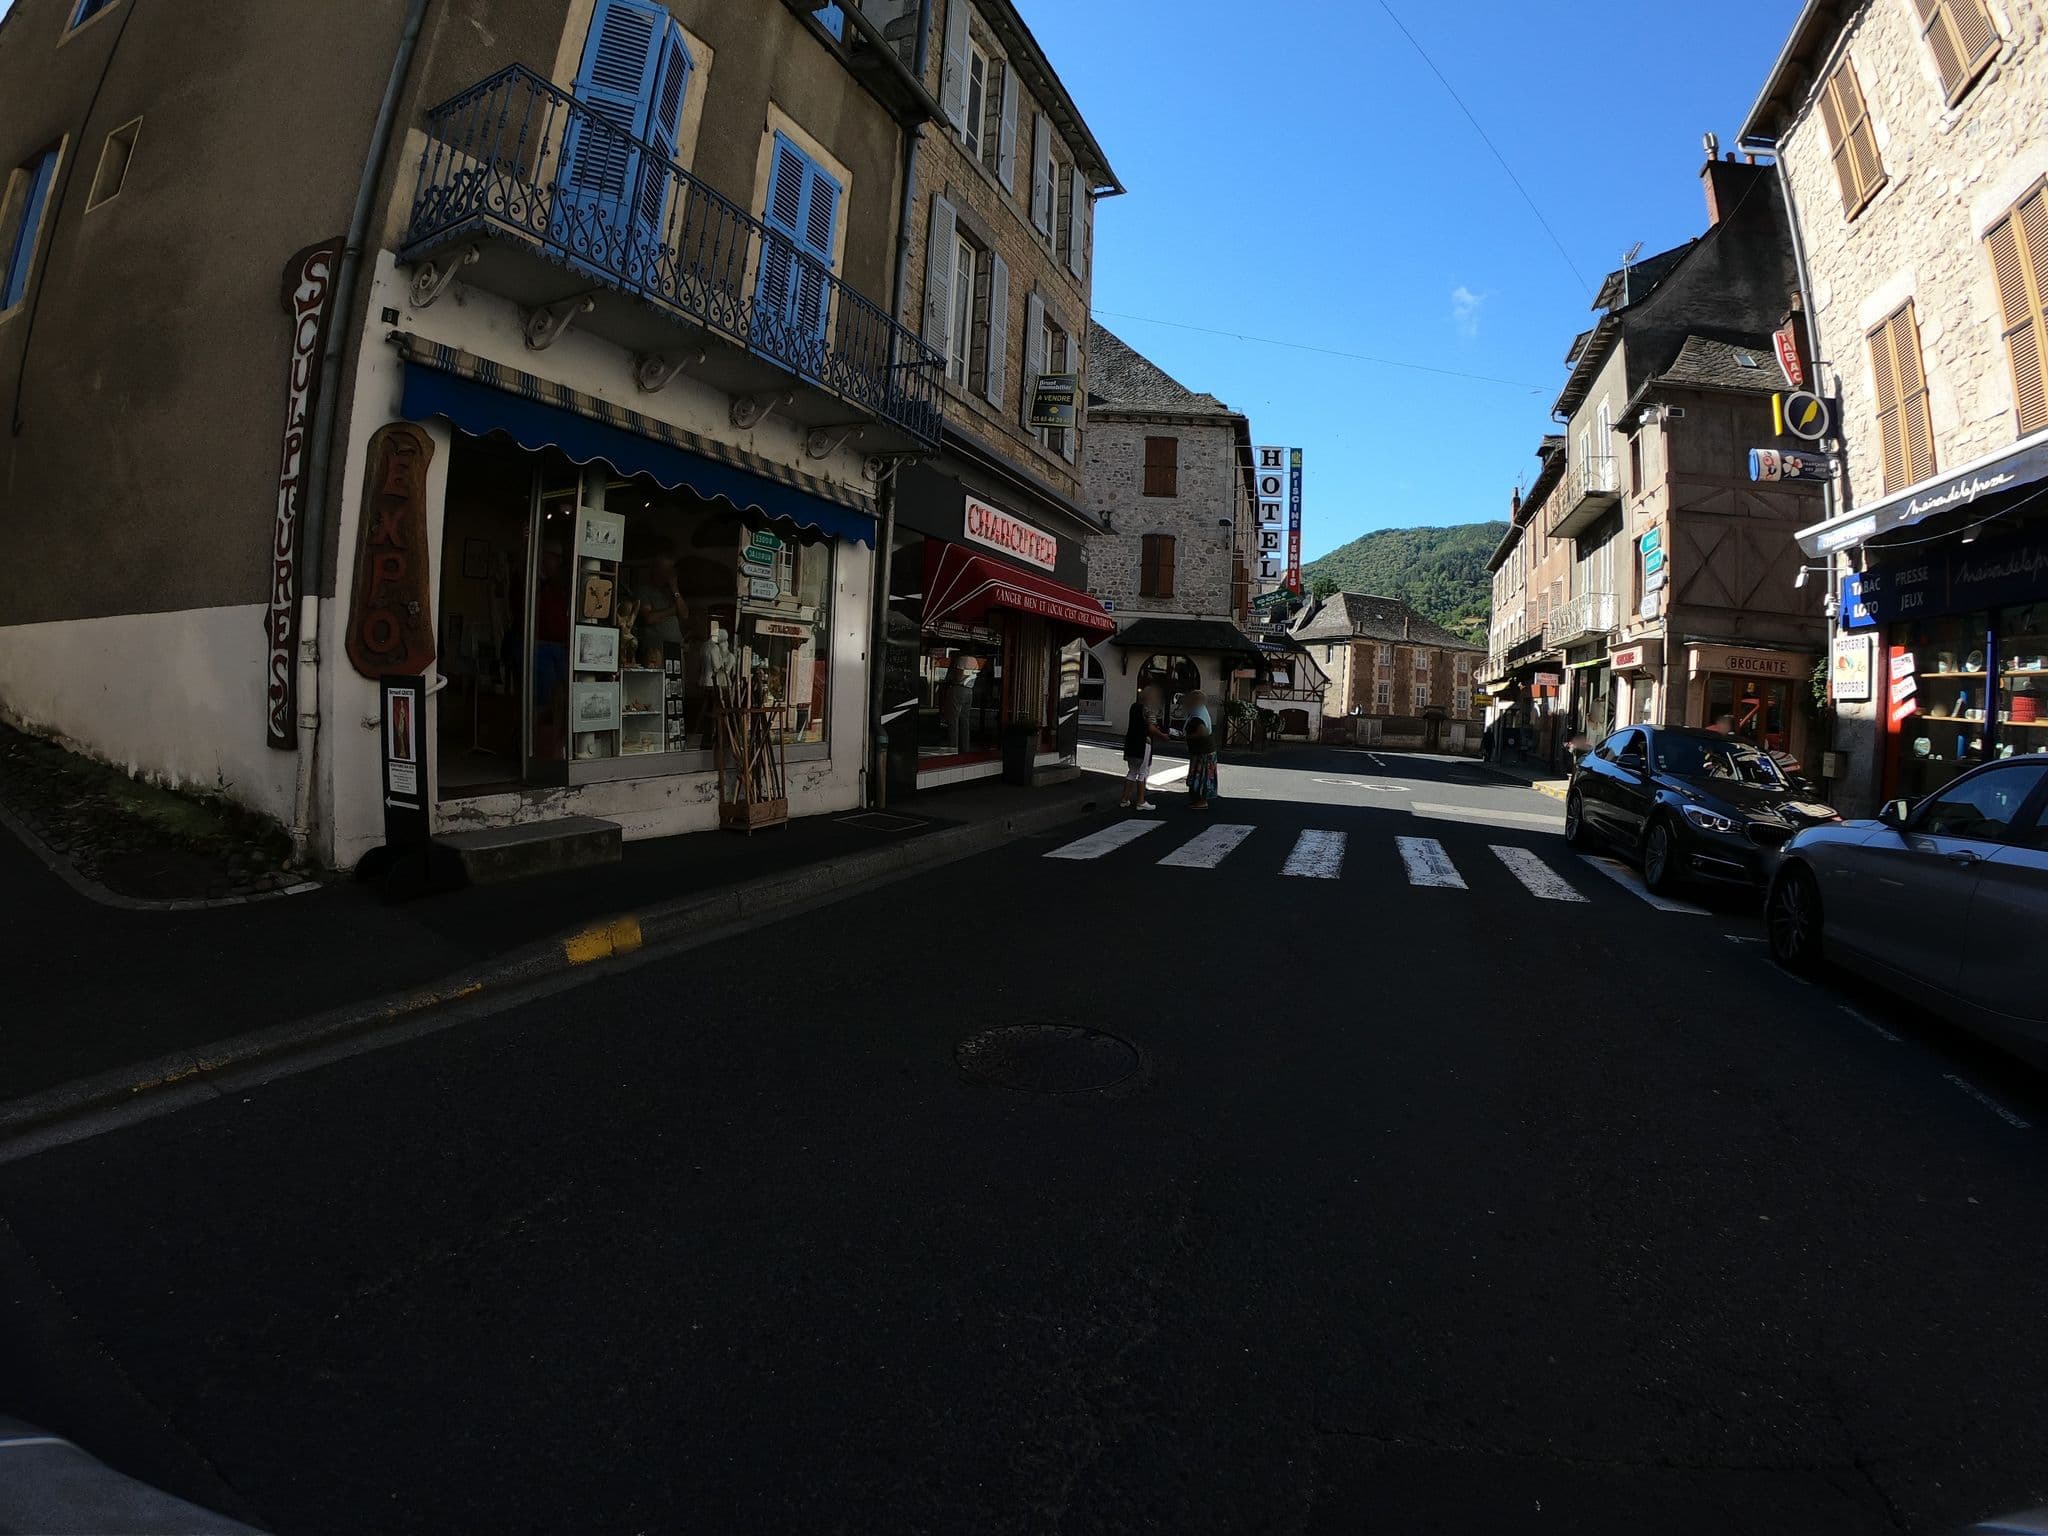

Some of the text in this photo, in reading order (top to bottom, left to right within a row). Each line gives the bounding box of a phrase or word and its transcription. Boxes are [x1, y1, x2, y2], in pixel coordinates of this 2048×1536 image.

[1777, 331, 1803, 382] TABAC
[270, 249, 333, 738] SCULPTURES
[1291, 471, 1300, 529] PISCINE
[1260, 449, 1282, 578] HOTEL
[363, 453, 410, 655] EXPO
[1289, 535, 1299, 587] TENNIS
[1851, 577, 1881, 596] TABAC
[1895, 566, 1929, 586] PRESSE
[1853, 600, 1879, 618] LOTO
[1901, 592, 1924, 612] JEUX
[1836, 638, 1865, 651] MERCERIE
[1730, 657, 1786, 672] BROCANTE
